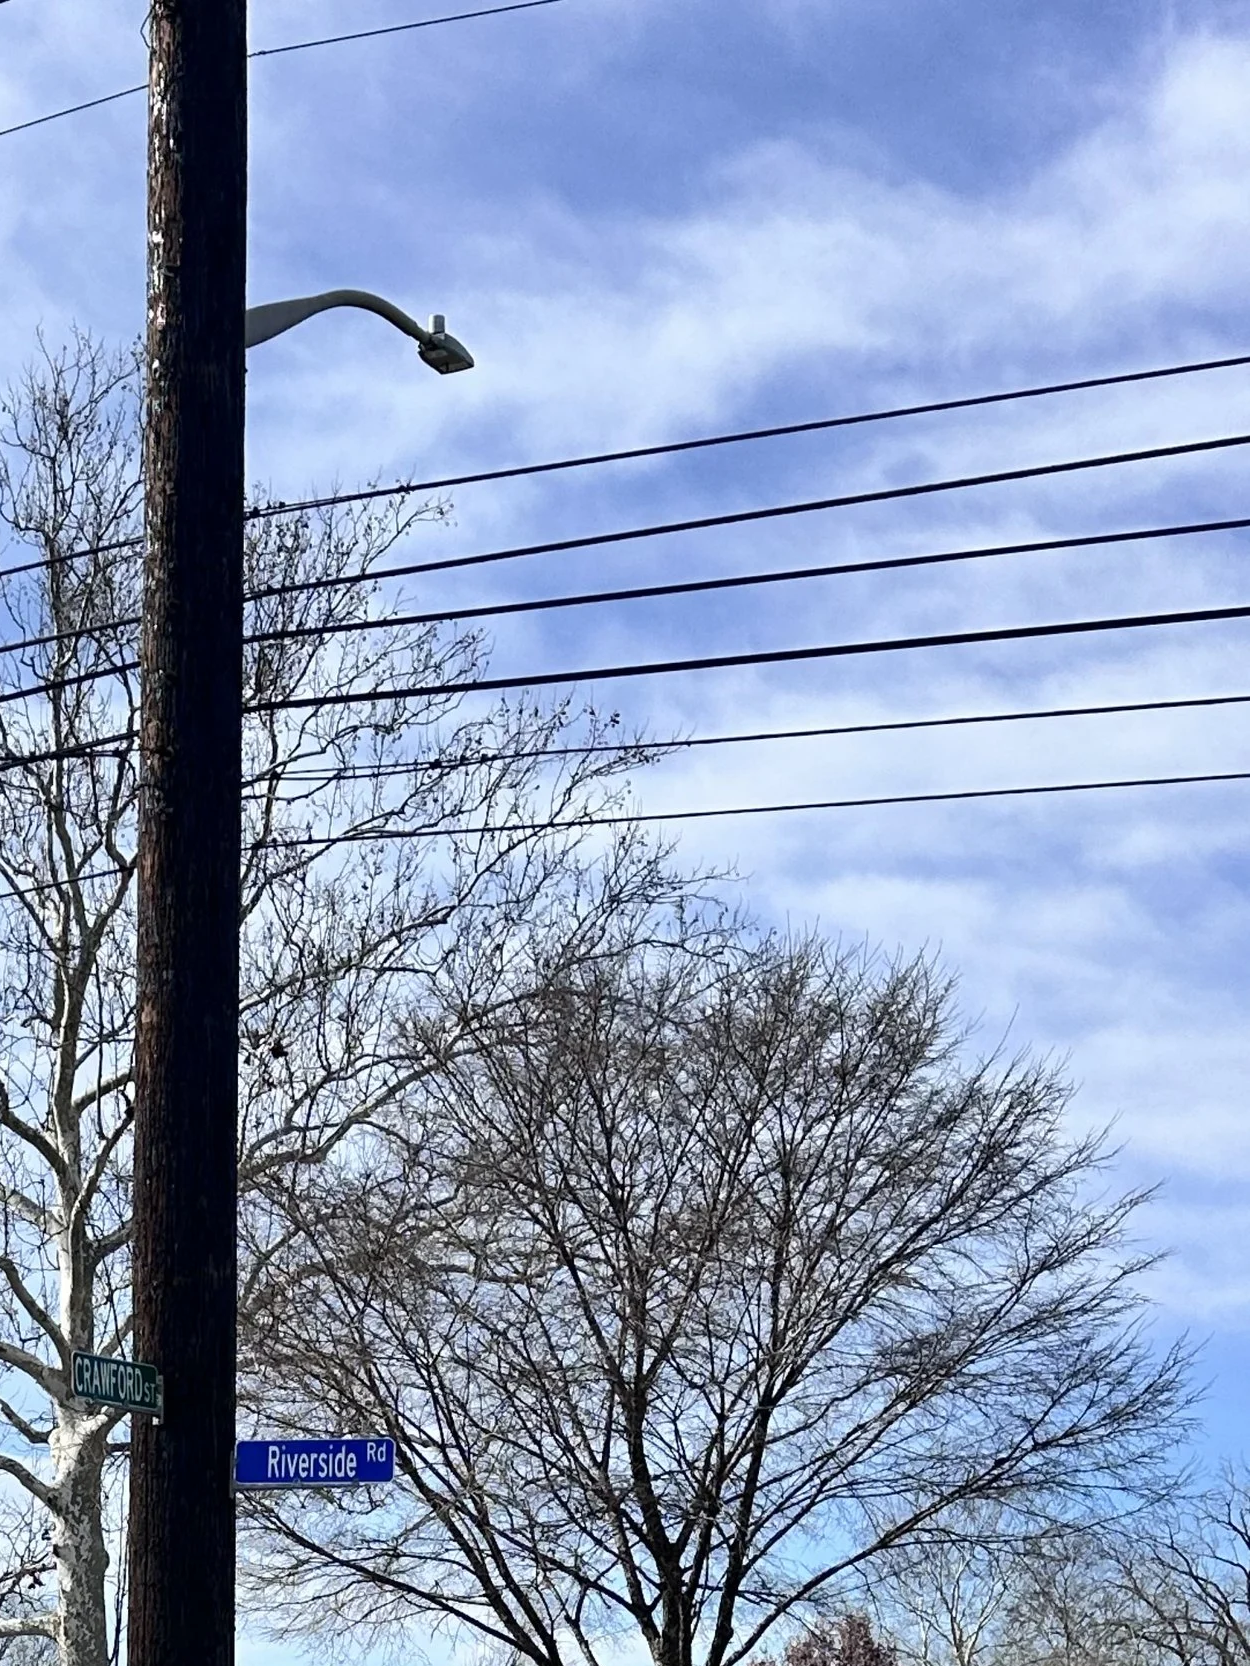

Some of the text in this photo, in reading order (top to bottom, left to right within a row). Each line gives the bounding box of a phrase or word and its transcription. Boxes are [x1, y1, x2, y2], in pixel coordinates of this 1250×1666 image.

[74, 1356, 156, 1404] CRAWFORD ST
[267, 1441, 387, 1479] Riverside Rd
